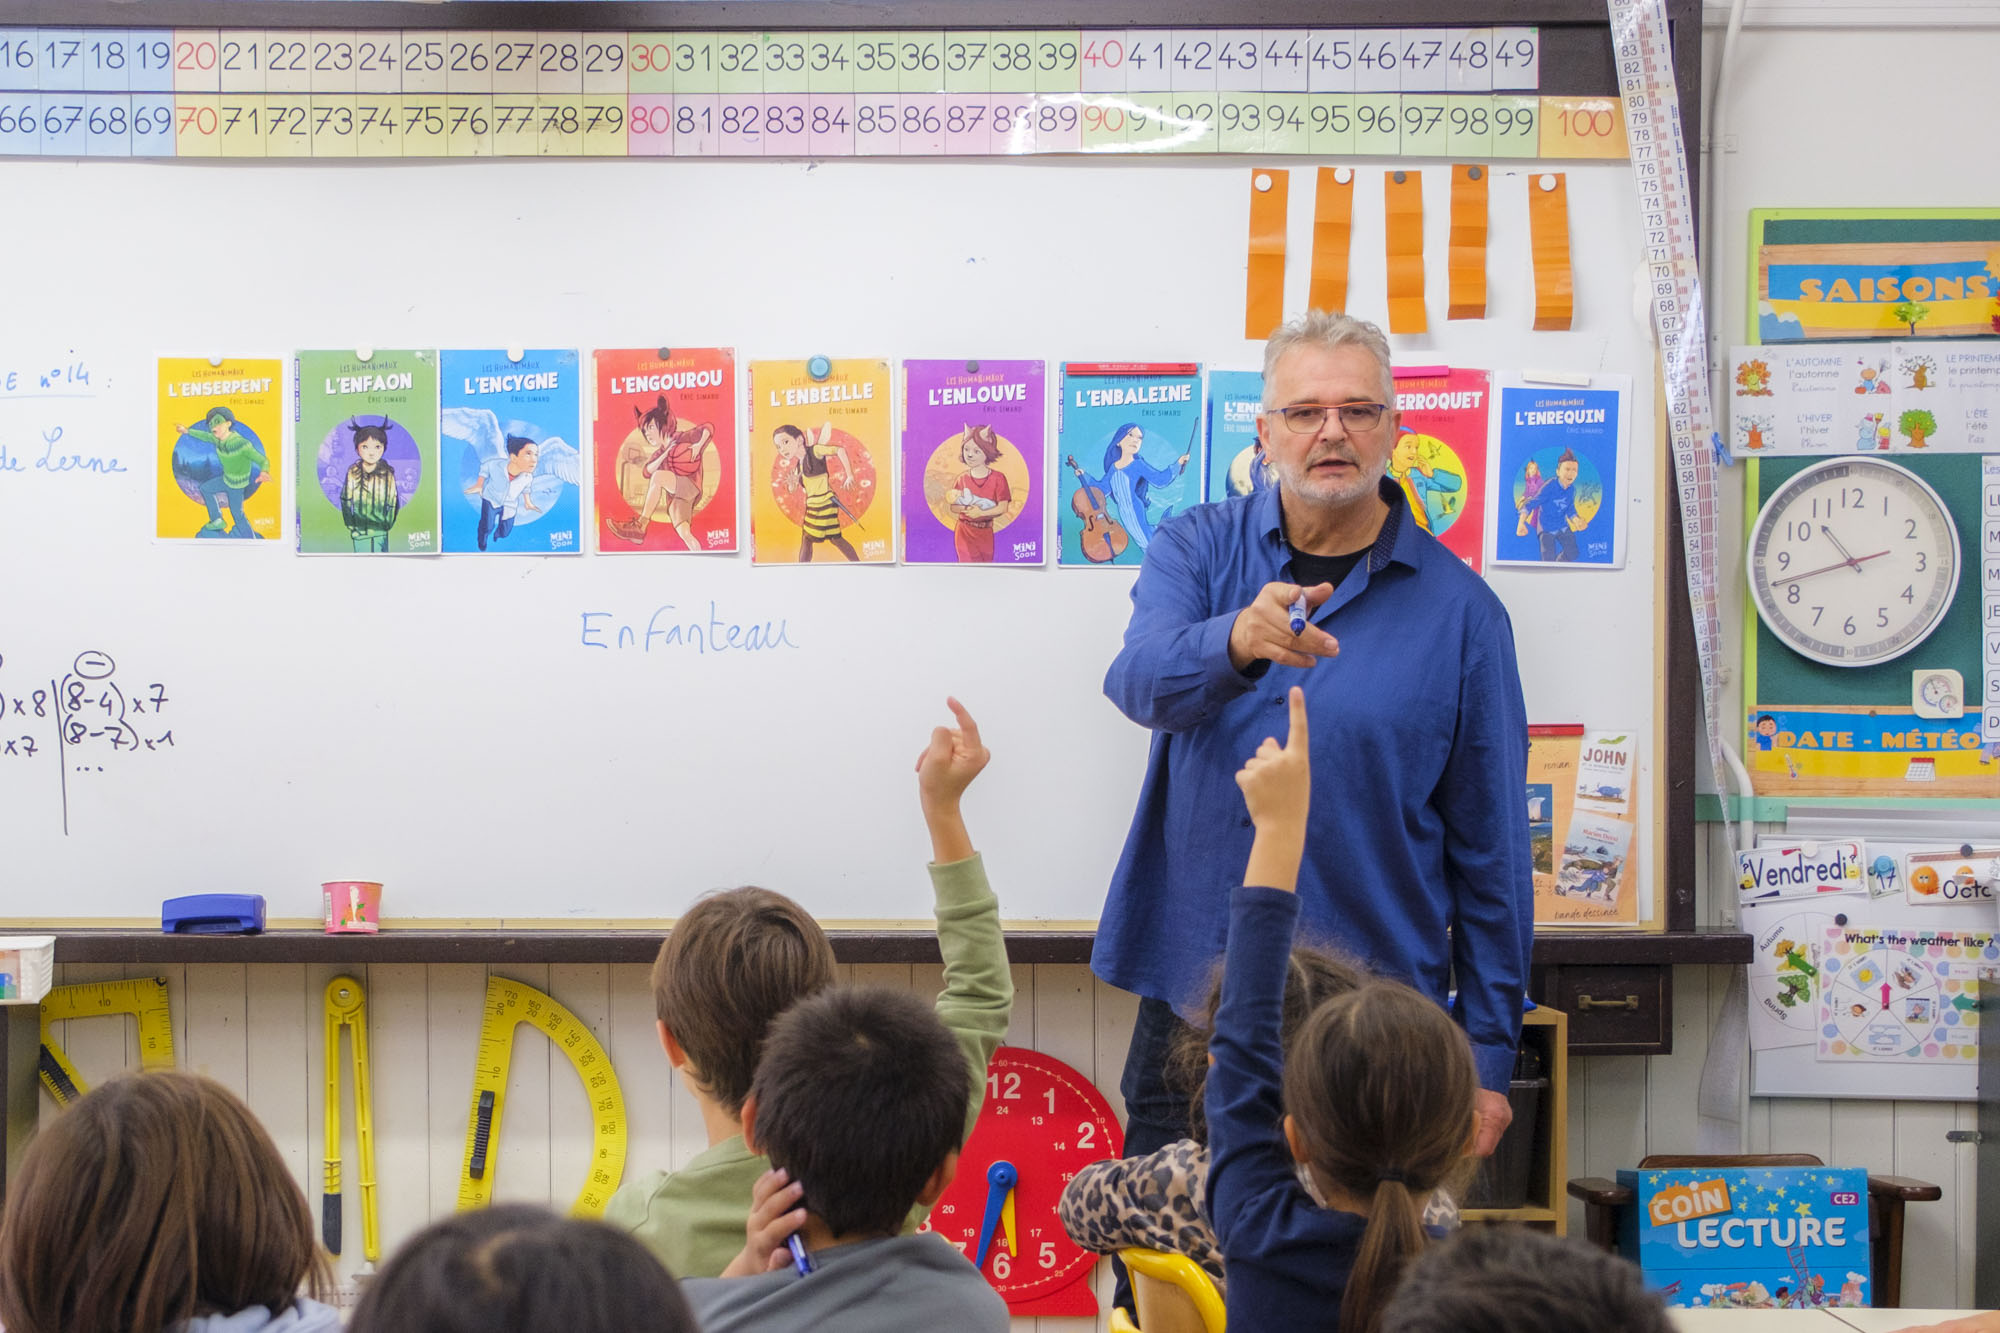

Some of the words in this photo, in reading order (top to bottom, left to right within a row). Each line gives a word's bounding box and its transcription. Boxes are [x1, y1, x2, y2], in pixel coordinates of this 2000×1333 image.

[0, 40, 33, 68] 16
[46, 41, 80, 68] 17
[91, 42, 124, 69] 18
[137, 42, 170, 69] 19
[177, 42, 216, 69] 20
[224, 42, 257, 70] 21
[268, 42, 306, 70] 22
[314, 43, 352, 70] 23
[359, 43, 396, 70] 24
[405, 43, 443, 70] 25
[451, 43, 488, 71] 26
[495, 43, 534, 71] 27
[540, 44, 578, 71] 28
[586, 44, 623, 72] 29
[632, 44, 670, 72] 30
[676, 44, 710, 71] 31
[721, 44, 758, 71] 32
[766, 44, 804, 71] 33
[811, 44, 848, 71] 34
[857, 43, 895, 70] 35
[901, 43, 939, 70] 36
[948, 43, 987, 71] 37
[993, 43, 1031, 70] 38
[1039, 43, 1077, 70] 39
[1084, 40, 1123, 67] 40
[1129, 43, 1162, 69] 41
[1174, 42, 1212, 69] 42
[1219, 42, 1258, 69] 43
[1265, 40, 1303, 66] 44
[1312, 42, 1351, 69] 45
[1358, 42, 1396, 69] 46
[1403, 42, 1442, 69] 47
[1449, 41, 1488, 68] 48
[1495, 41, 1533, 67] 49
[1621, 45, 1637, 57] 83
[1624, 61, 1640, 73] 82
[0, 106, 36, 133] 66
[44, 106, 83, 133] 67
[89, 107, 127, 134] 68
[135, 107, 171, 134] 69
[177, 107, 217, 135] 70
[222, 107, 257, 134] 71
[267, 107, 306, 135] 72
[313, 107, 352, 135] 73
[358, 107, 397, 134] 74
[403, 107, 443, 134] 75
[449, 107, 488, 135] 76
[494, 106, 534, 133] 77
[540, 106, 579, 134] 78
[584, 106, 623, 133] 79
[631, 106, 670, 133] 80
[677, 106, 710, 133] 81
[722, 106, 760, 133] 82
[766, 106, 804, 133] 83
[812, 106, 850, 133] 84
[858, 106, 896, 133] 85
[903, 106, 940, 133] 86
[947, 106, 986, 133] 87
[1039, 106, 1077, 131] 89
[1221, 105, 1261, 133] 93
[1267, 105, 1304, 132] 94
[1311, 105, 1350, 133] 95
[1358, 106, 1396, 133] 96
[1404, 106, 1443, 134] 97
[1450, 108, 1488, 135] 98
[1495, 108, 1534, 135] 99
[1559, 109, 1614, 137] 100
[1631, 113, 1647, 125] 79
[1634, 130, 1650, 141] 78
[1641, 181, 1657, 193] 75
[1647, 215, 1663, 226] 73
[1650, 232, 1665, 243] 72
[1800, 276, 1990, 301] SAISONS
[325, 372, 413, 395] L'ENFAON
[464, 371, 559, 395] L'ENCYGNE
[611, 369, 723, 395] L'ENGOUROU
[1789, 369, 1839, 379] l'automne
[168, 378, 272, 398] L'ENSERPENT
[770, 382, 873, 407] L'ENBEILLE
[928, 383, 1027, 406] L'ENLOUVE
[1076, 384, 1192, 408] L'ENBALEINE
[1394, 391, 1484, 411] ERROQUET
[1515, 409, 1605, 426] L'ENREQUIN
[36, 426, 127, 473] Lerne
[1812, 498, 1831, 518] 11
[1841, 488, 1865, 509] 12
[1884, 496, 1888, 517] 1
[1788, 521, 1811, 542] 10
[1904, 520, 1917, 539] 2
[1778, 552, 1790, 572] 9
[1915, 552, 1927, 572] 3
[1787, 584, 1800, 605] 8
[1901, 585, 1914, 604] 4
[1812, 606, 1825, 626] 7
[1843, 616, 1856, 636] 6
[1876, 607, 1888, 628] 5
[581, 599, 800, 654] Enfanteau
[1778, 731, 1854, 748] DATE
[1881, 728, 1981, 749] MÉTÉO
[1583, 748, 1627, 766] JOHN
[1749, 850, 1847, 888] Vendredi
[1760, 925, 1785, 952] Autumn
[1845, 933, 1885, 945] What's
[1888, 934, 1906, 945] the
[1910, 935, 1958, 948] weather
[1964, 937, 1984, 947] like
[1988, 938, 1994, 947] ?
[504, 990, 518, 999] 170
[527, 999, 542, 1010] 160
[526, 1008, 537, 1017] 20
[549, 1012, 563, 1025] 150
[568, 1029, 581, 1043] 140
[987, 1073, 1021, 1099] 12
[996, 1106, 1009, 1115] 24
[1043, 1088, 1055, 1114] 1
[1031, 1117, 1043, 1126] 13
[1077, 1122, 1095, 1149] 2
[1053, 1142, 1065, 1151] 14
[942, 1205, 955, 1214] 20
[1833, 1194, 1856, 1205] CE2
[963, 1228, 975, 1237] 19
[1030, 1228, 1042, 1238] 17
[1677, 1217, 1846, 1248] LECTURE
[993, 1253, 1010, 1279] 6
[1038, 1243, 1056, 1269] 5
